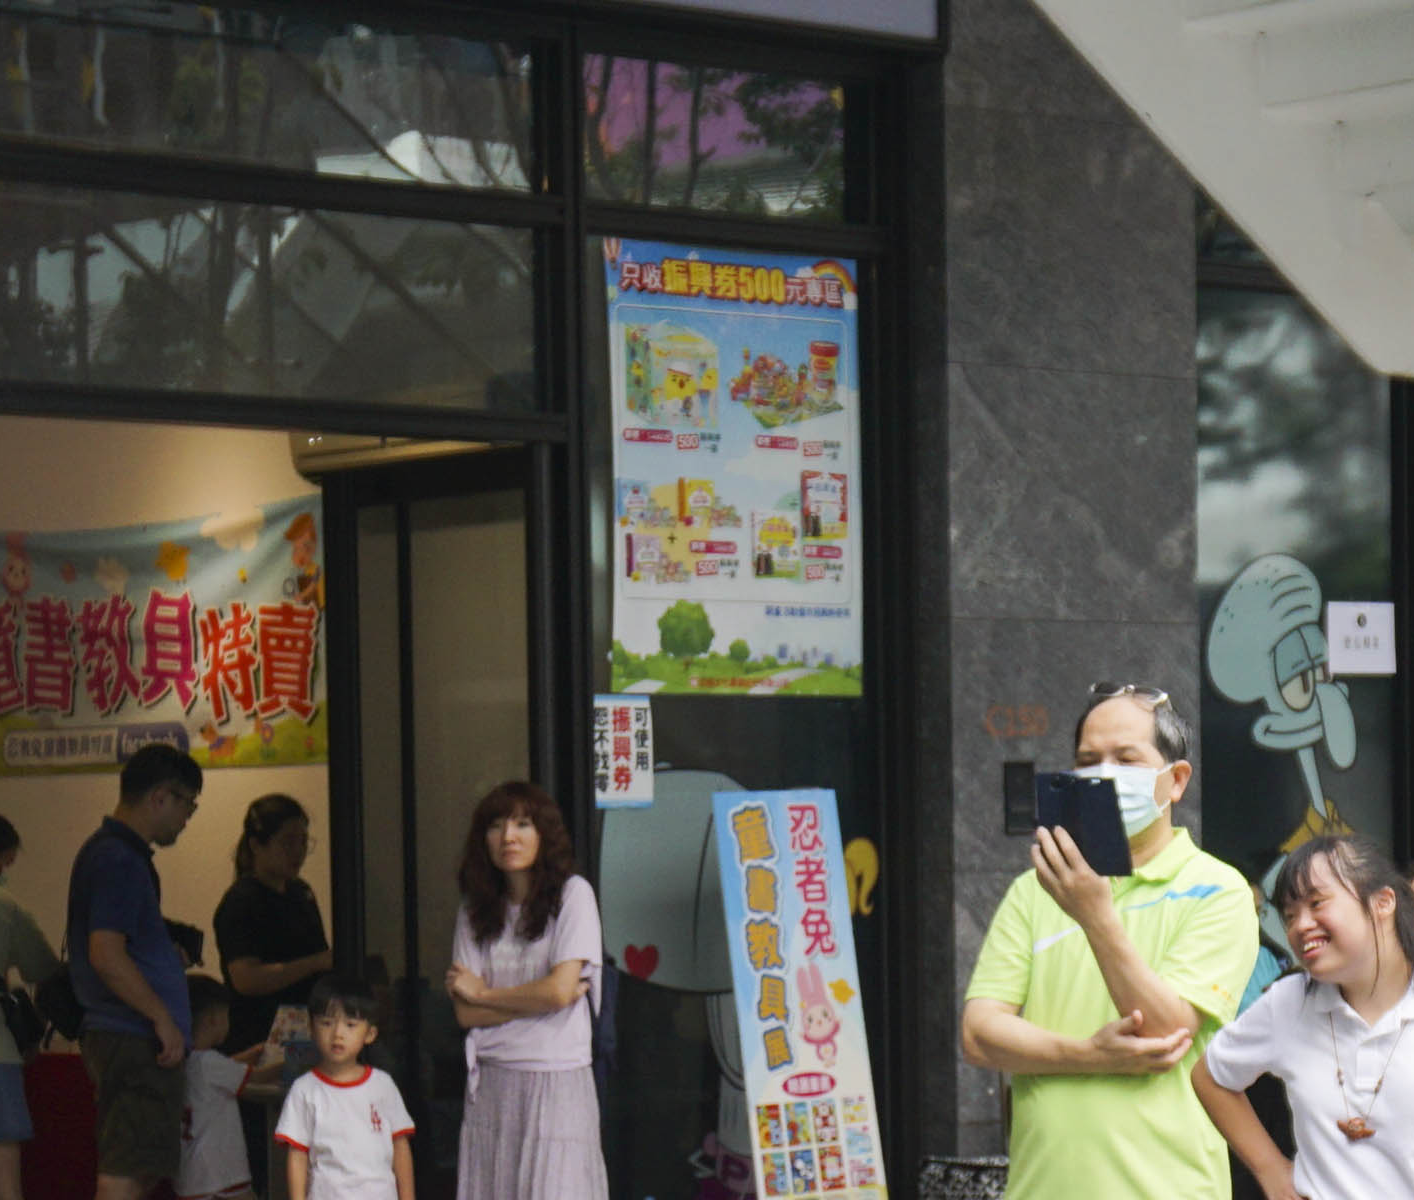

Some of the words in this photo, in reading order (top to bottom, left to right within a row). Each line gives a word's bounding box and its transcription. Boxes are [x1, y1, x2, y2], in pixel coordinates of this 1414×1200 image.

[620, 258, 845, 307] 只收振興券500元專區
[732, 806, 793, 1071] 童書教具展
[787, 804, 836, 955] 忍者兔
